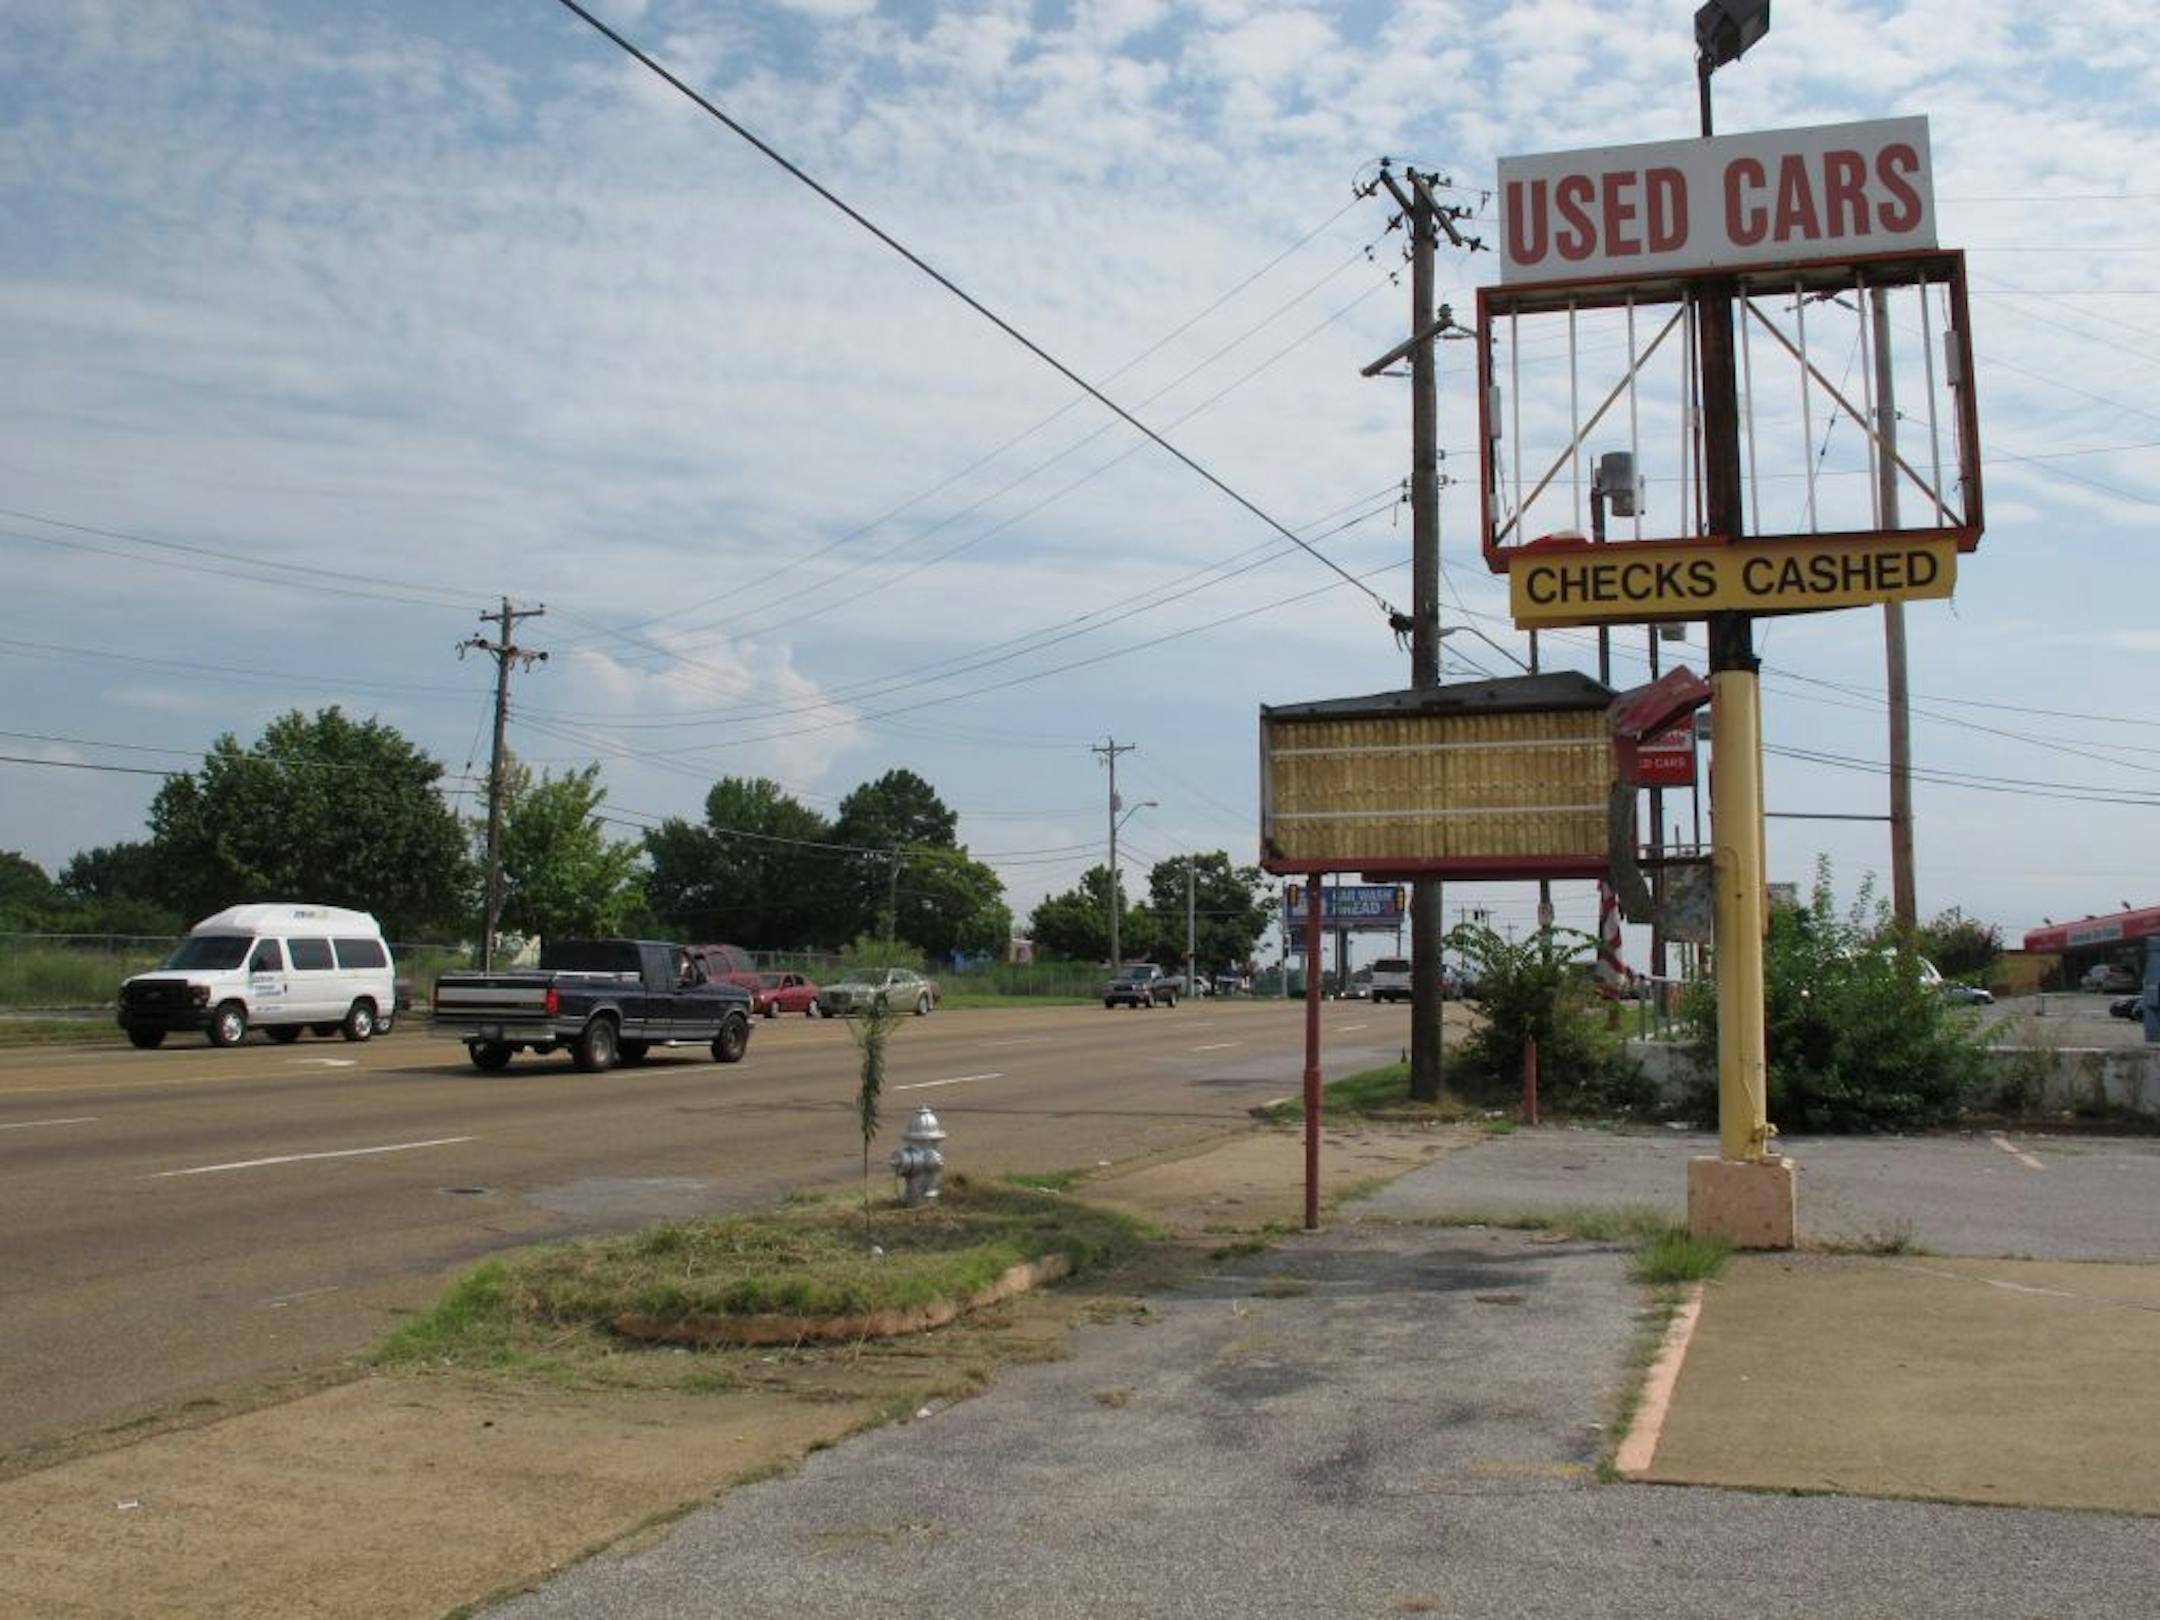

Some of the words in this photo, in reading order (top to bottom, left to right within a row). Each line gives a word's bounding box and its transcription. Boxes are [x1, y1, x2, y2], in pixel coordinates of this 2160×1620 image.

[1507, 166, 1690, 267] USED
[1723, 142, 1923, 248] CARS
[1526, 560, 1717, 605] CHECKS
[1742, 549, 1939, 597] CASHED
[1654, 756, 1686, 769] CARS
